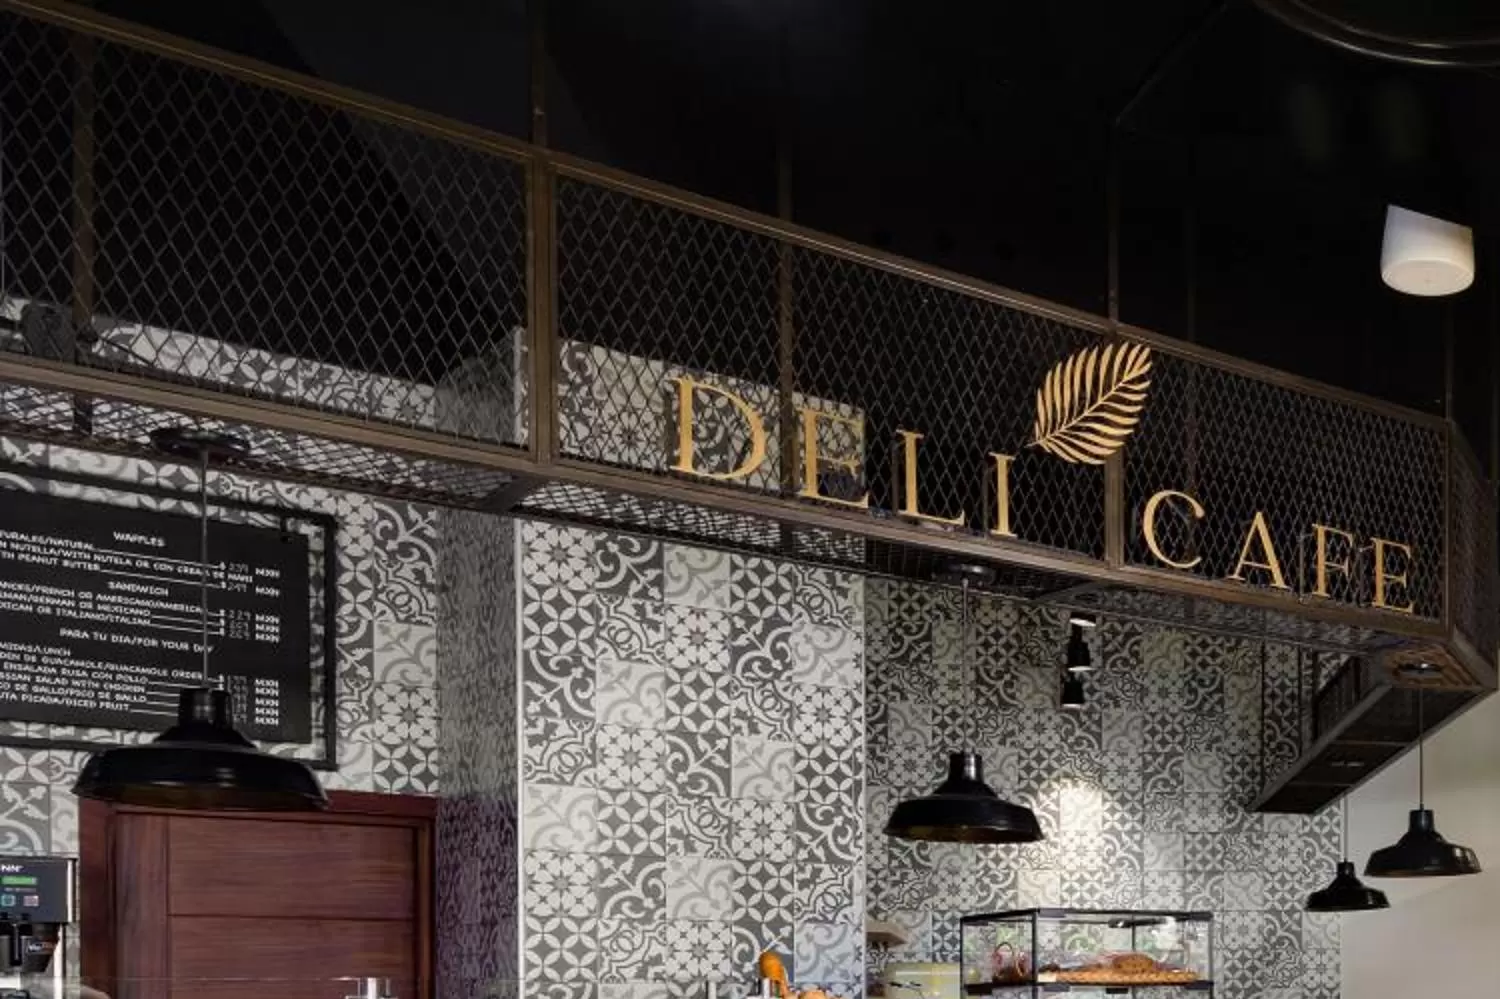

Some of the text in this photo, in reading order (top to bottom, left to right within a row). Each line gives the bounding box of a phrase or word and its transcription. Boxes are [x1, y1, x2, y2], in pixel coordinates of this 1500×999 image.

[668, 374, 1018, 538] DELI
[113, 531, 165, 547] WAFFLES
[1143, 489, 1414, 614] CAFE
[255, 568, 280, 578] MXN
[107, 581, 168, 596] SANDWICH
[255, 586, 280, 598] MXN
[255, 613, 280, 625] MXN
[255, 623, 280, 634] MXN
[60, 628, 89, 640] PARA
[93, 631, 107, 641] TU
[162, 640, 189, 650] YOUR
[255, 633, 280, 644] MXN
[255, 678, 279, 688] MXN
[255, 687, 279, 697] MXN
[255, 697, 279, 707] MXN
[255, 707, 279, 717] MXN
[255, 716, 279, 726] MXN
